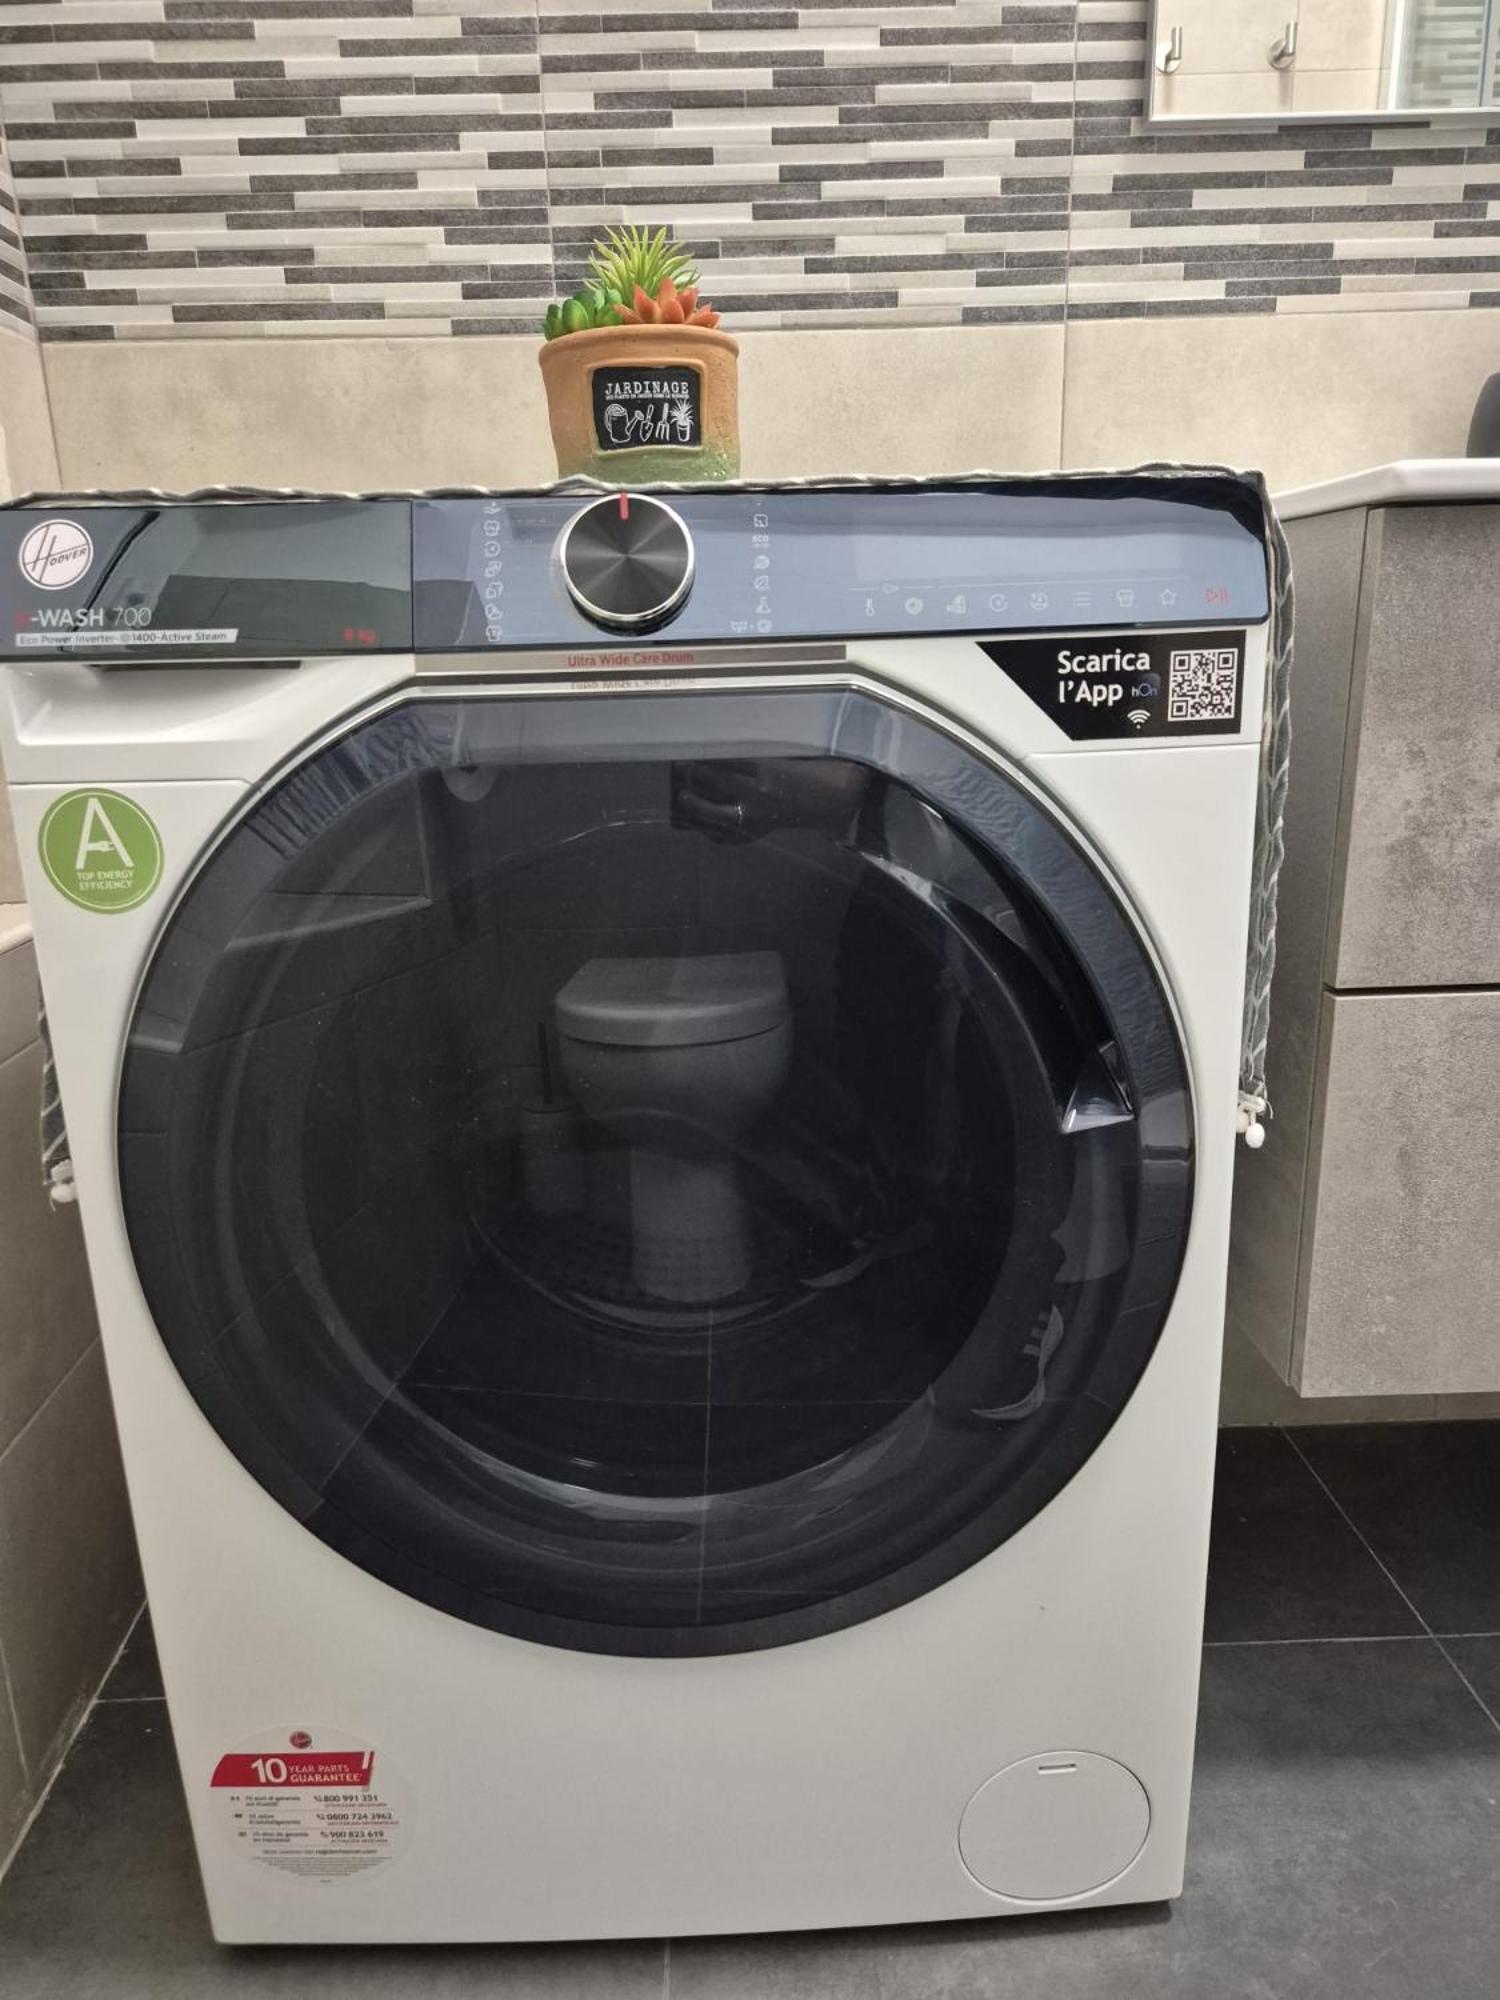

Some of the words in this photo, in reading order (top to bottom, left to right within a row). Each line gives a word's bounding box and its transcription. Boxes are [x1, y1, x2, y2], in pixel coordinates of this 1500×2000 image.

[605, 381, 689, 395] JARDINAGE
[112, 607, 152, 627] 700
[195, 631, 227, 641] Steam
[567, 655, 597, 667] Ultra
[599, 653, 630, 665] Wide
[633, 651, 659, 664] Care
[661, 650, 694, 663] Drum
[1057, 649, 1150, 674] Scarica
[75, 797, 135, 870] A
[77, 871, 95, 880] TOP
[97, 869, 135, 880] ENERGY
[251, 1758, 288, 1783] 10
[288, 1766, 315, 1774] YEAR
[318, 1764, 350, 1773] PARTS
[289, 1772, 361, 1783] GUARANTEE
[342, 1794, 359, 1802] 991
